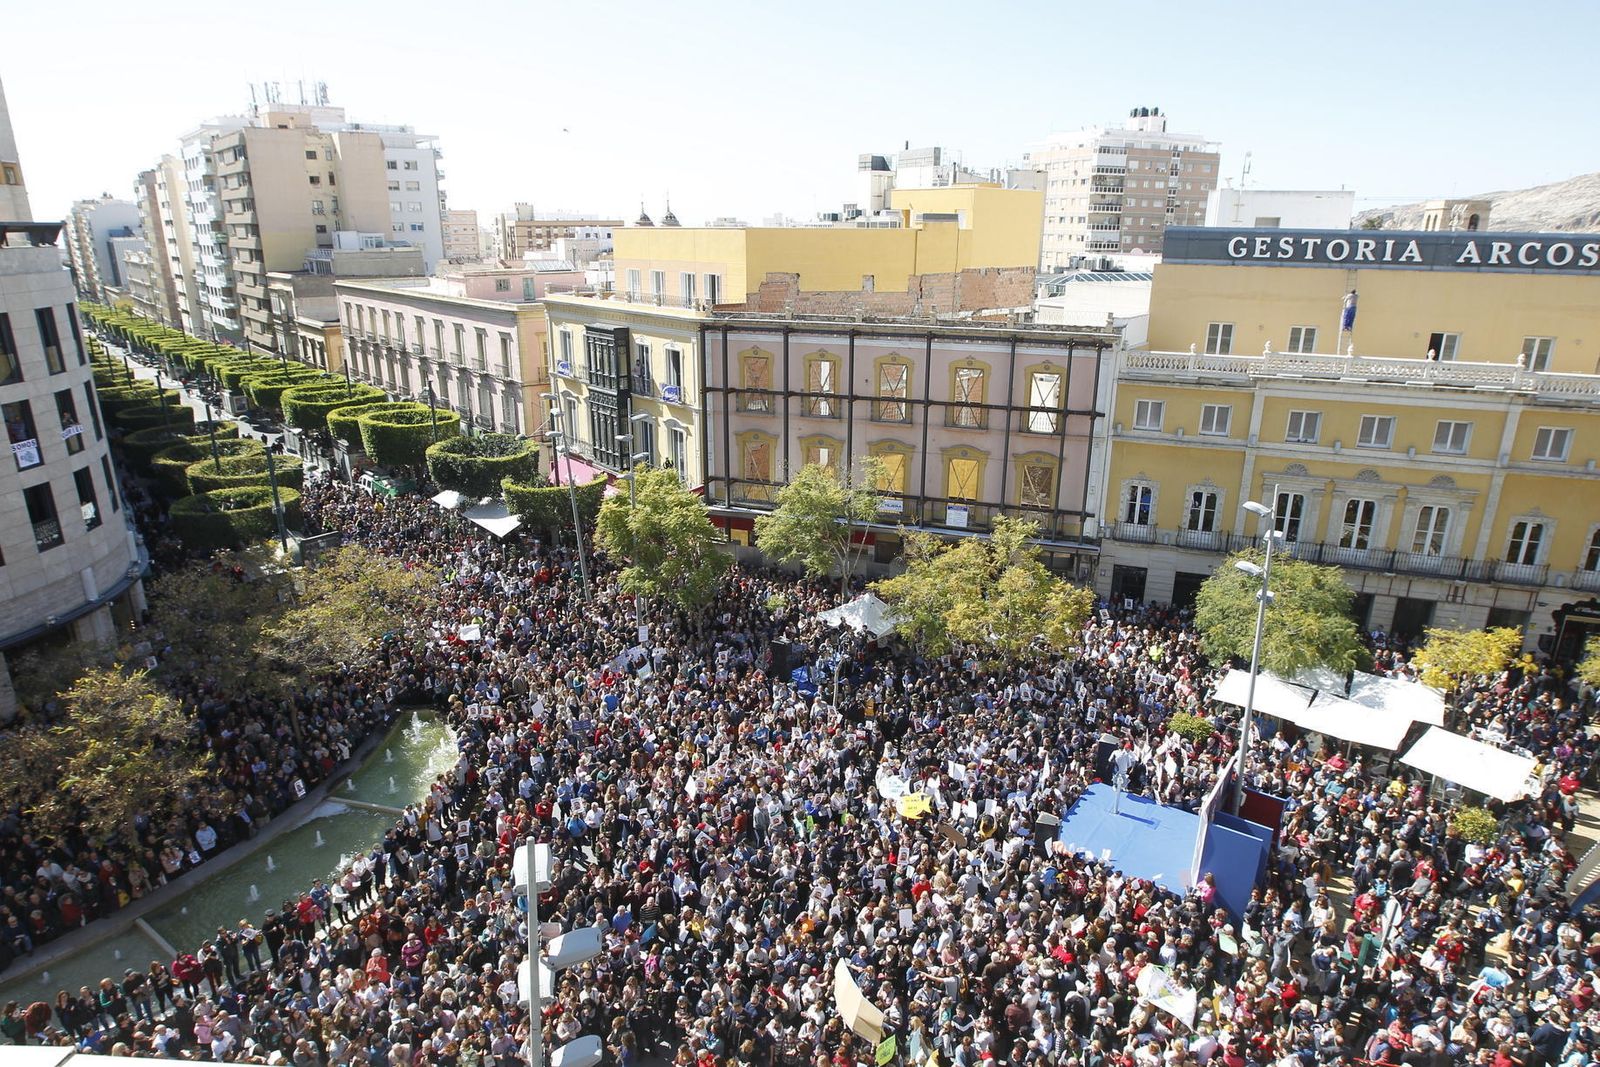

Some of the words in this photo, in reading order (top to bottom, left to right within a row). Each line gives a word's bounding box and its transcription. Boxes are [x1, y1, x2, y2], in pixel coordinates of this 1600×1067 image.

[1228, 236, 1423, 262] GESTORIA
[1456, 240, 1600, 266] ARCOS
[11, 440, 36, 452] SOMOS
